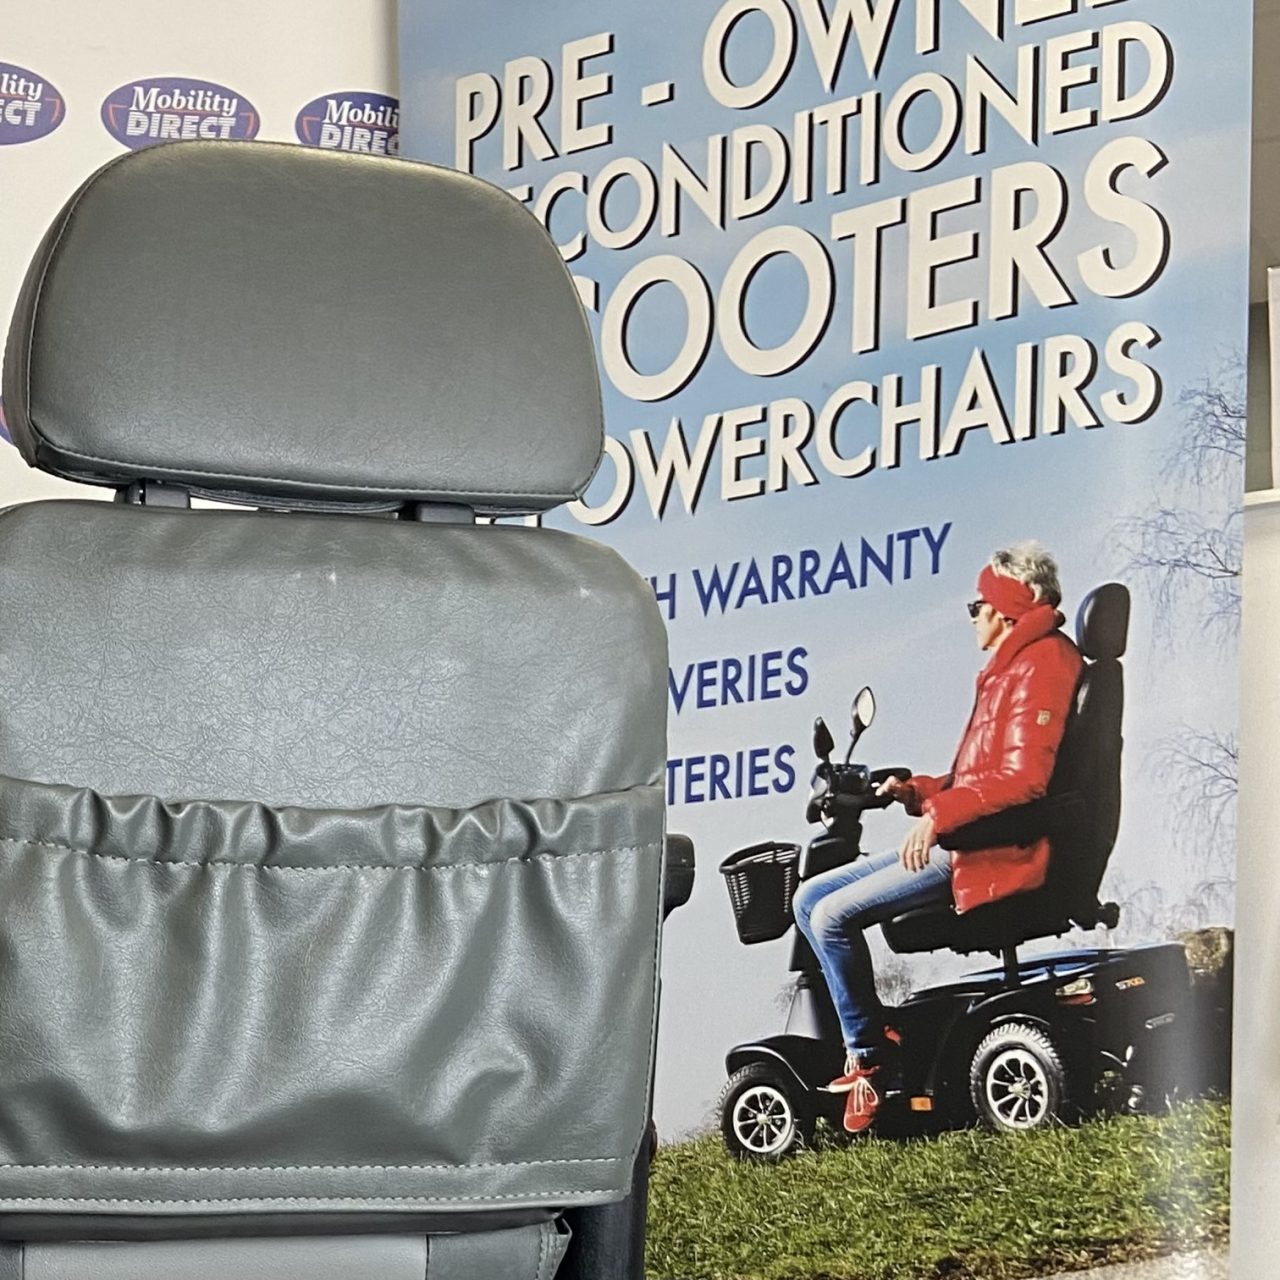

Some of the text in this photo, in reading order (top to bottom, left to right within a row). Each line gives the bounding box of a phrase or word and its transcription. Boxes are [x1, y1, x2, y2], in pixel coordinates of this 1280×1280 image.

[126, 111, 237, 139] DIRECT
[129, 86, 238, 116] Mobility
[455, 32, 615, 176] PRE
[508, 20, 1175, 263] CONDITIONED
[523, 321, 1162, 527] OWERCHAIRS
[692, 522, 953, 618] WARRANTY
[668, 647, 809, 716] VERIES
[666, 744, 796, 806] TERIES
